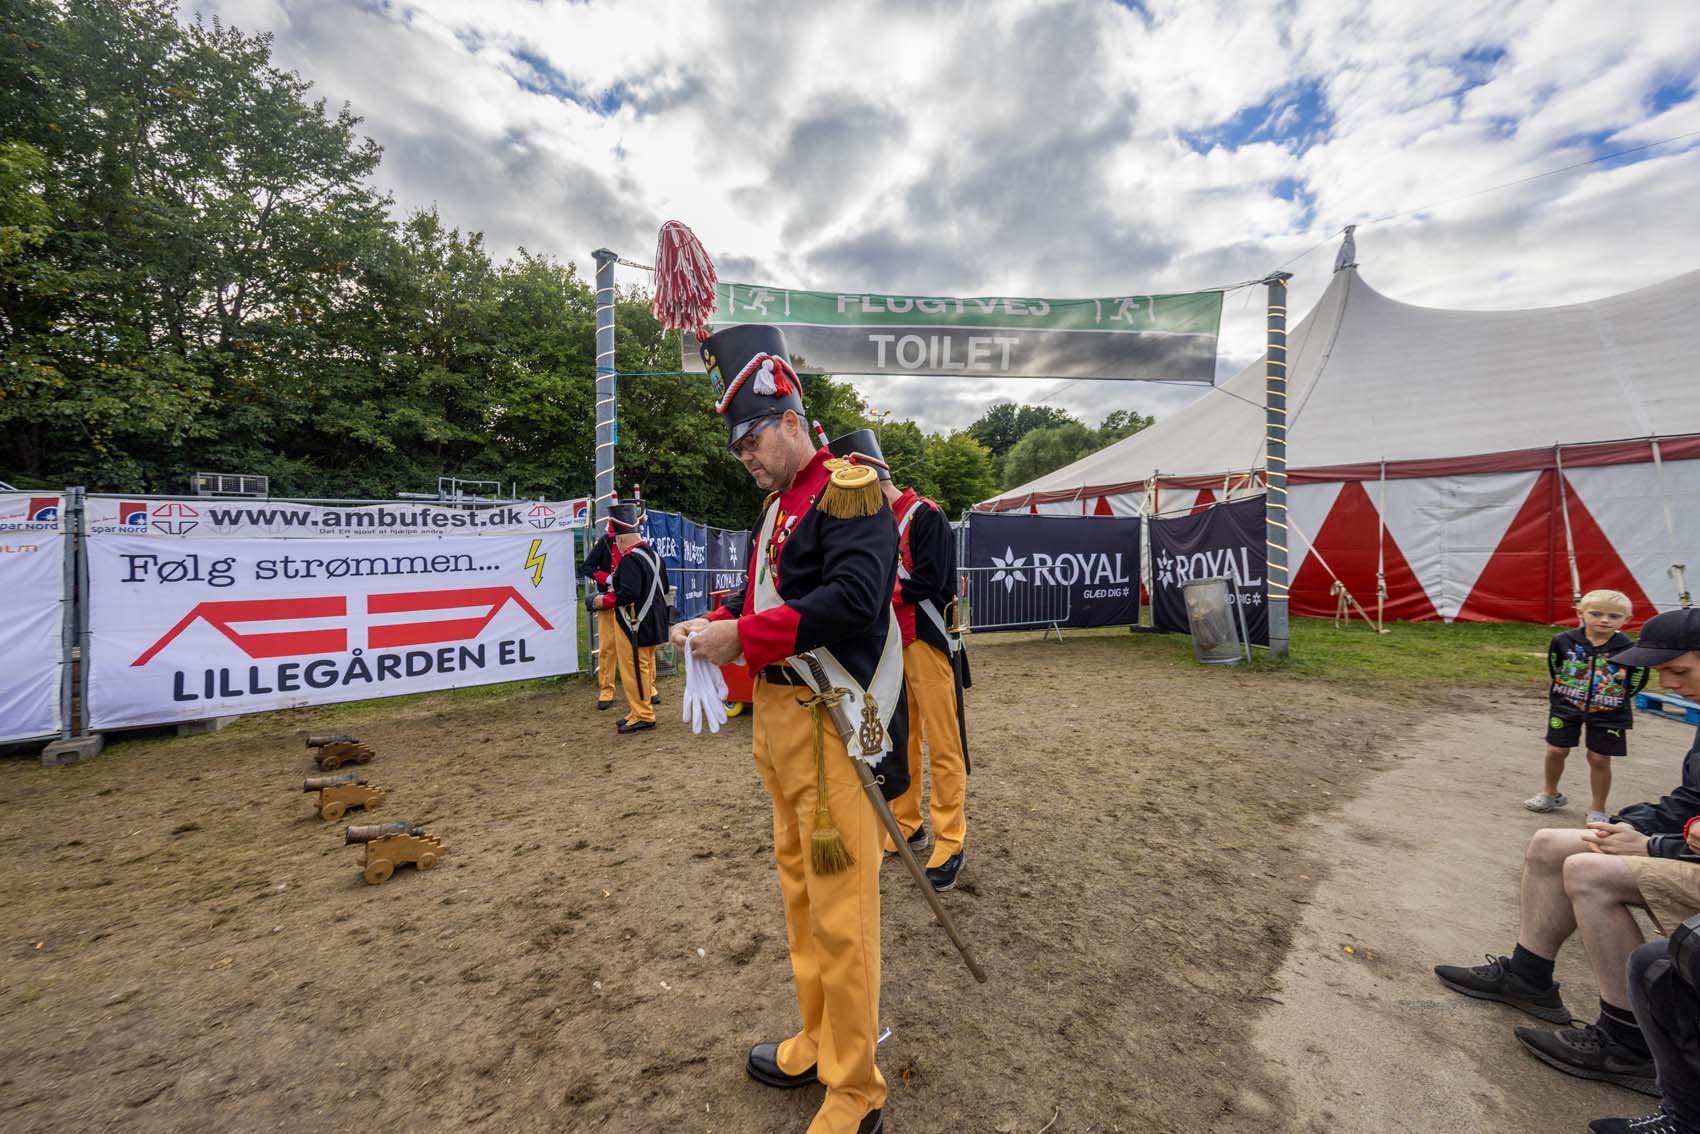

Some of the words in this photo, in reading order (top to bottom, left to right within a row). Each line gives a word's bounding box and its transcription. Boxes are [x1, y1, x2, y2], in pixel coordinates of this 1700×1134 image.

[868, 334, 1020, 370] TOILET
[208, 507, 524, 527] www.ambufest.dk
[119, 554, 237, 587] Følg
[255, 553, 500, 581] strømmen...
[1032, 553, 1129, 586] ROYAL
[1175, 546, 1262, 588] ROYAL
[1107, 588, 1122, 598] DIG
[173, 643, 486, 702] LILLEGÅRDEN
[498, 639, 536, 666] EL
